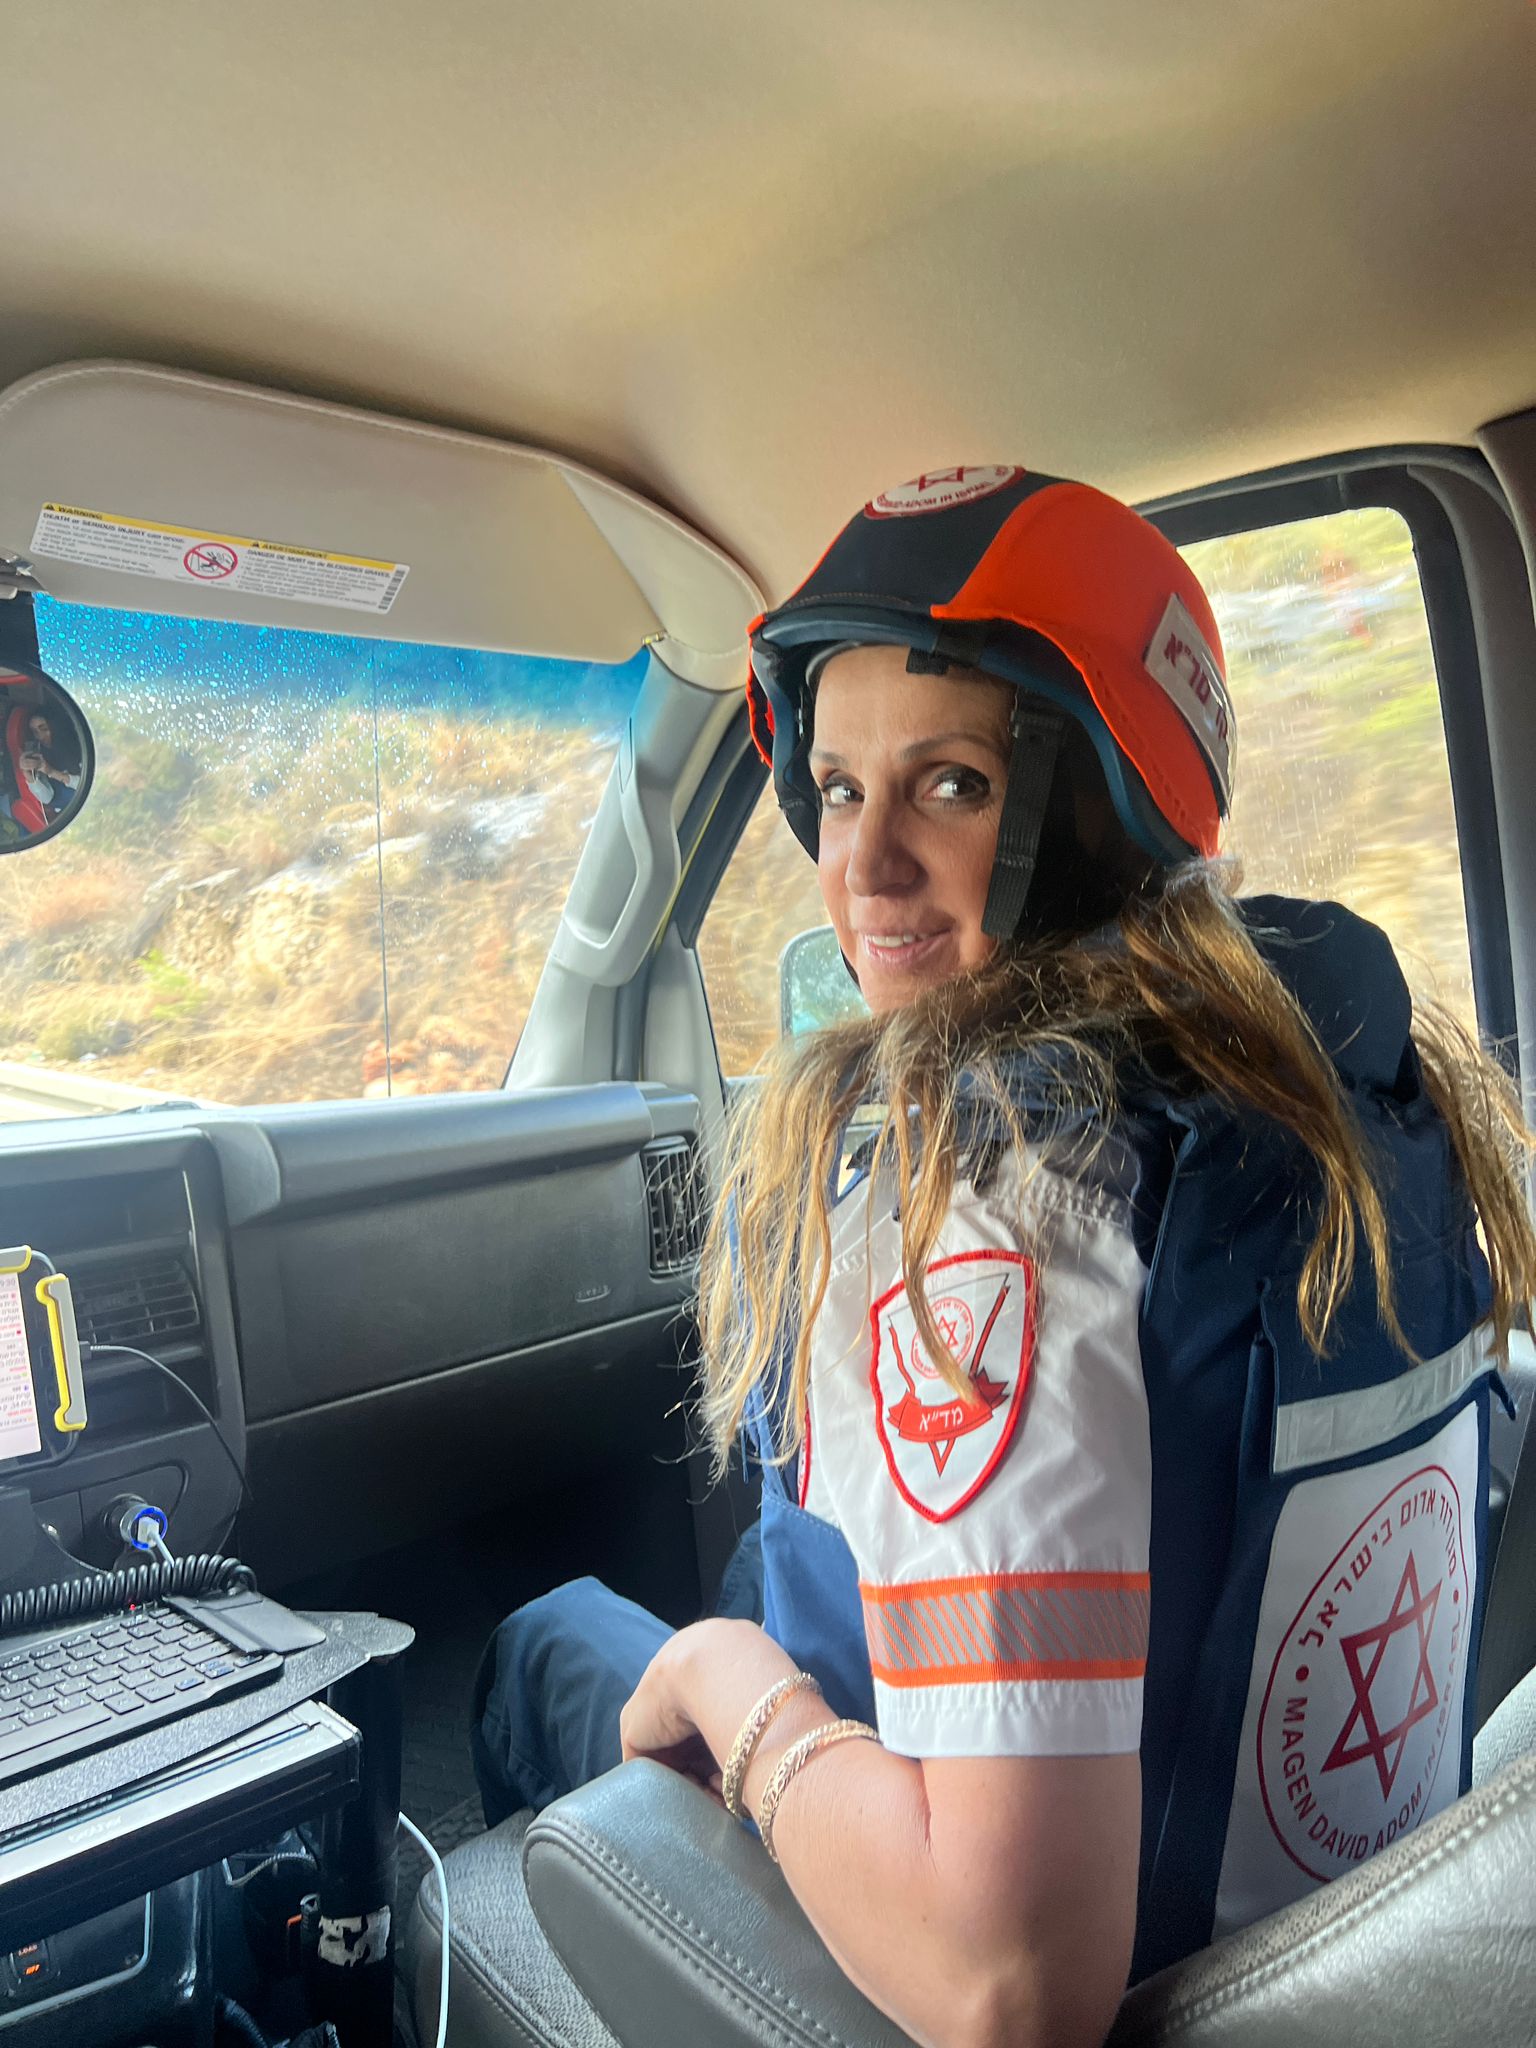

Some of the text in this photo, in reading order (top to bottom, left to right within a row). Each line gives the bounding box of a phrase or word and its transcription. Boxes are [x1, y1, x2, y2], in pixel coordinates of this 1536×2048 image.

[58, 505, 103, 520] WARNING
[1399, 1488, 1437, 1528] אדום
[1298, 1516, 1393, 1649] בישראל
[1281, 1696, 1318, 1821] MAGEN
[1306, 1813, 1369, 1860] DAVID
[1373, 1781, 1422, 1856] ADOM
